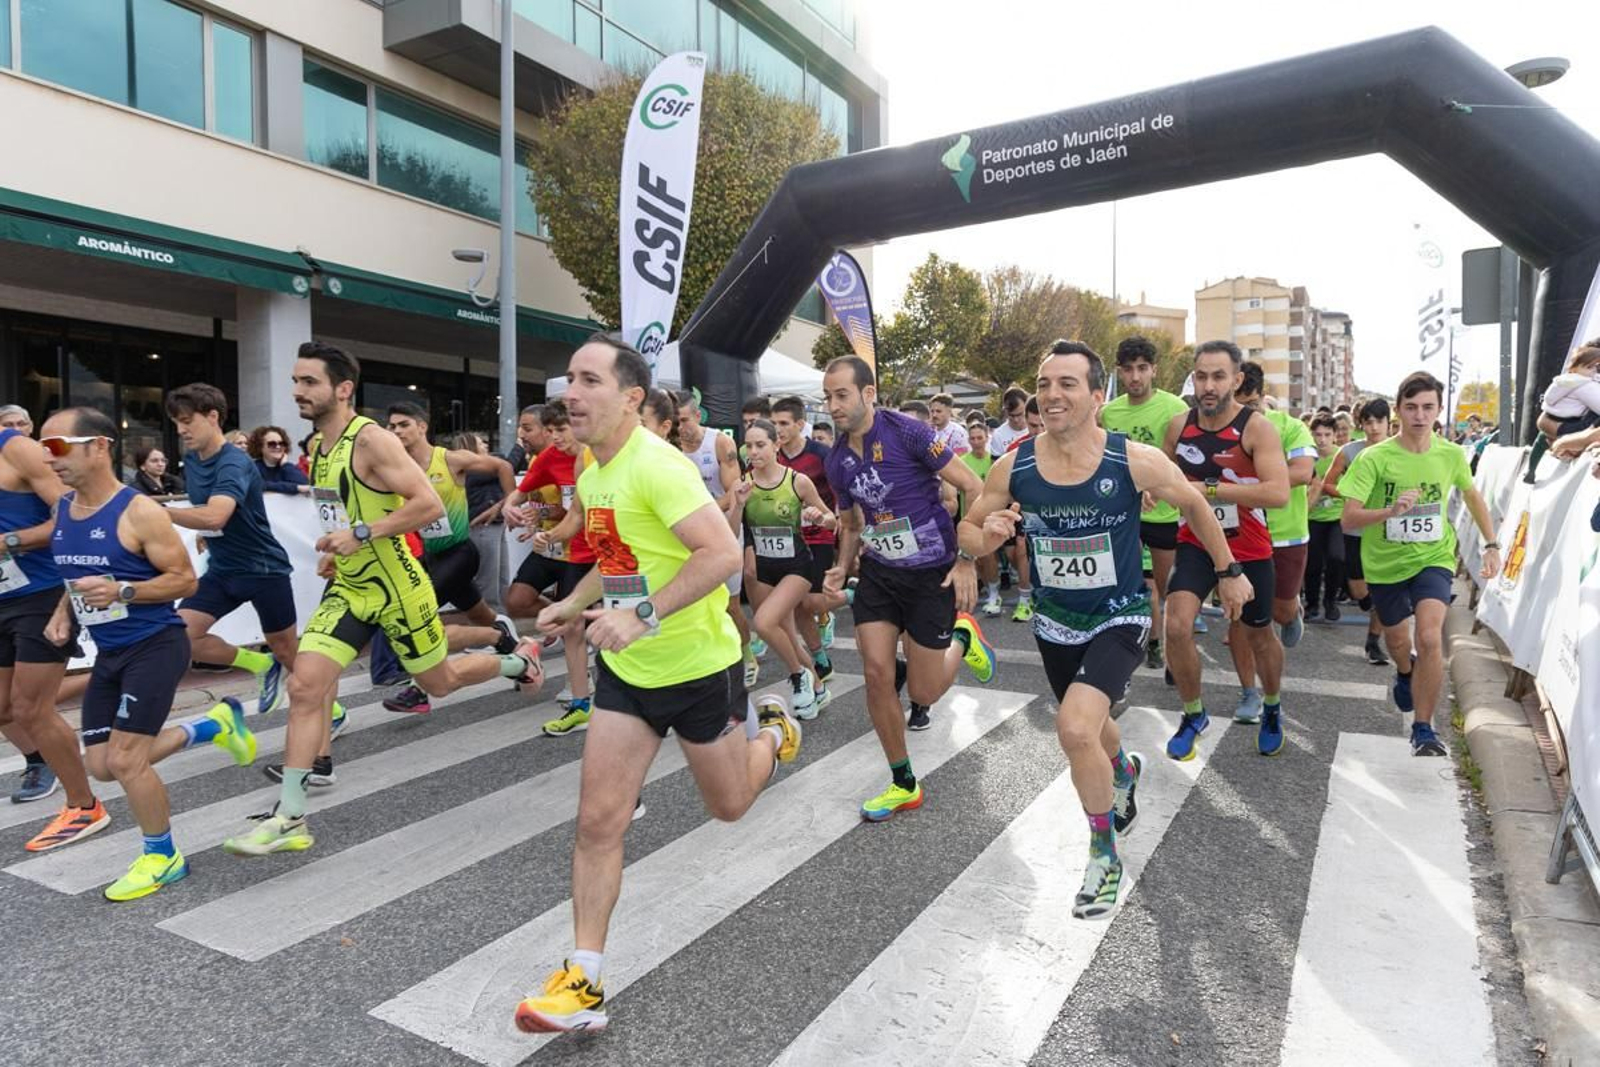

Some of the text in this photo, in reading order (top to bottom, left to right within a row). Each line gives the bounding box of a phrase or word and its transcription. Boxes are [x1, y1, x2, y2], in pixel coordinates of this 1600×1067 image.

[651, 97, 694, 117] CSIF
[982, 113, 1174, 165] Patronato Municipal de
[983, 144, 1128, 184] Deportes de Jaén
[633, 162, 686, 295] CSIF
[1040, 504, 1099, 518] RUNNING
[1400, 518, 1433, 533] 155
[761, 538, 785, 551] 115
[871, 534, 904, 552] 315
[1051, 556, 1097, 577] 240
